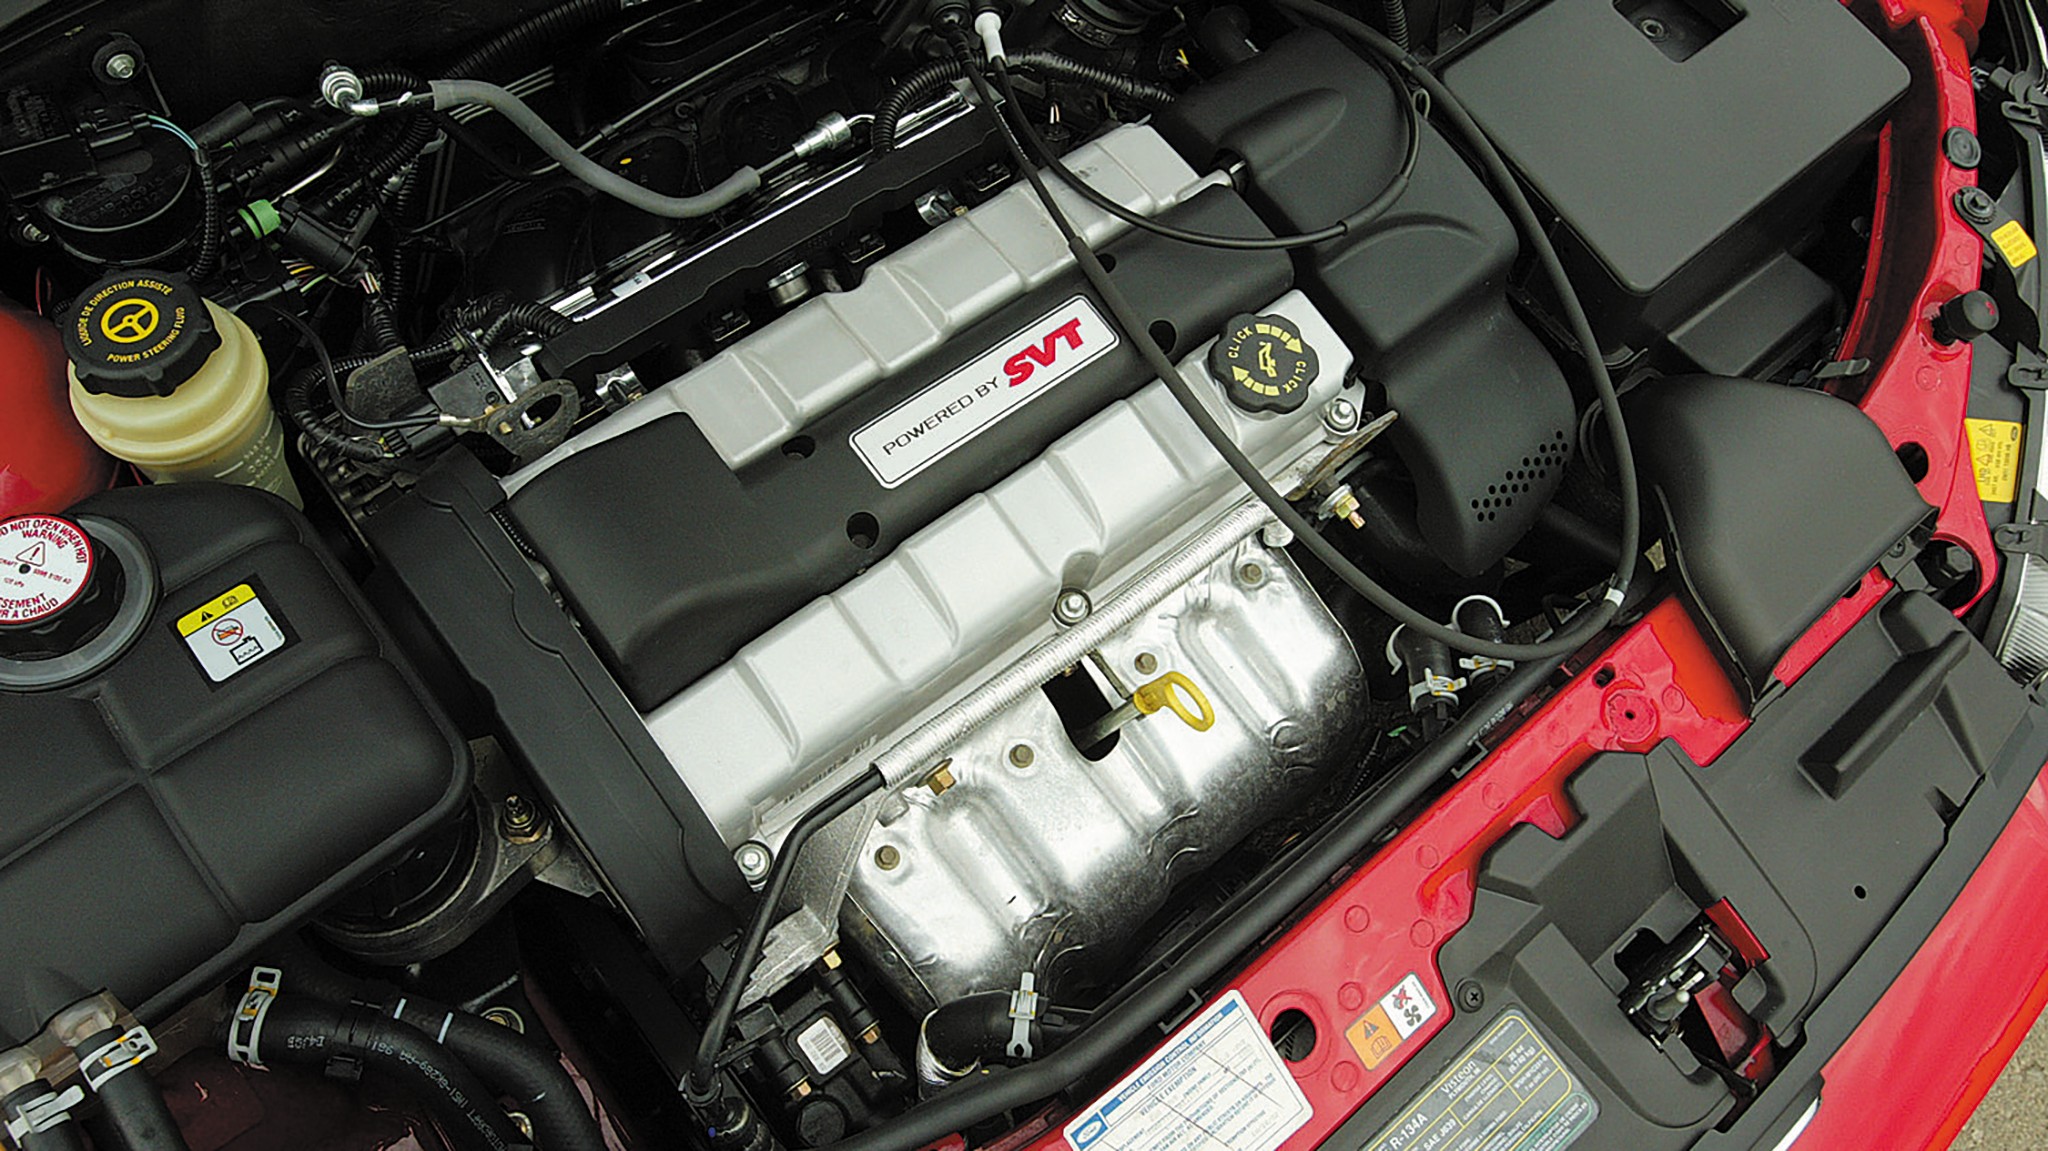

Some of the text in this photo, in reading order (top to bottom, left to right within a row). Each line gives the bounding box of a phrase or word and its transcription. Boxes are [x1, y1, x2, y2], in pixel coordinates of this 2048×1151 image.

[89, 280, 135, 306] DIRECTION
[106, 306, 185, 363] POWER STEERING FLUID
[1228, 326, 1253, 358] CLICK
[882, 317, 1084, 456] POWERED BY SVT
[1282, 361, 1307, 394] CLICK
[10, 520, 30, 532] NOT
[32, 519, 62, 532] OPEN
[59, 525, 83, 549] WHEN
[75, 547, 87, 563] HOT
[22, 529, 69, 549] WARNING
[11, 610, 19, 618] A
[22, 597, 59, 618] CHAUD
[1389, 1059, 1477, 1150] R-134A Visteon
[1423, 1130, 1443, 1151] SAE
